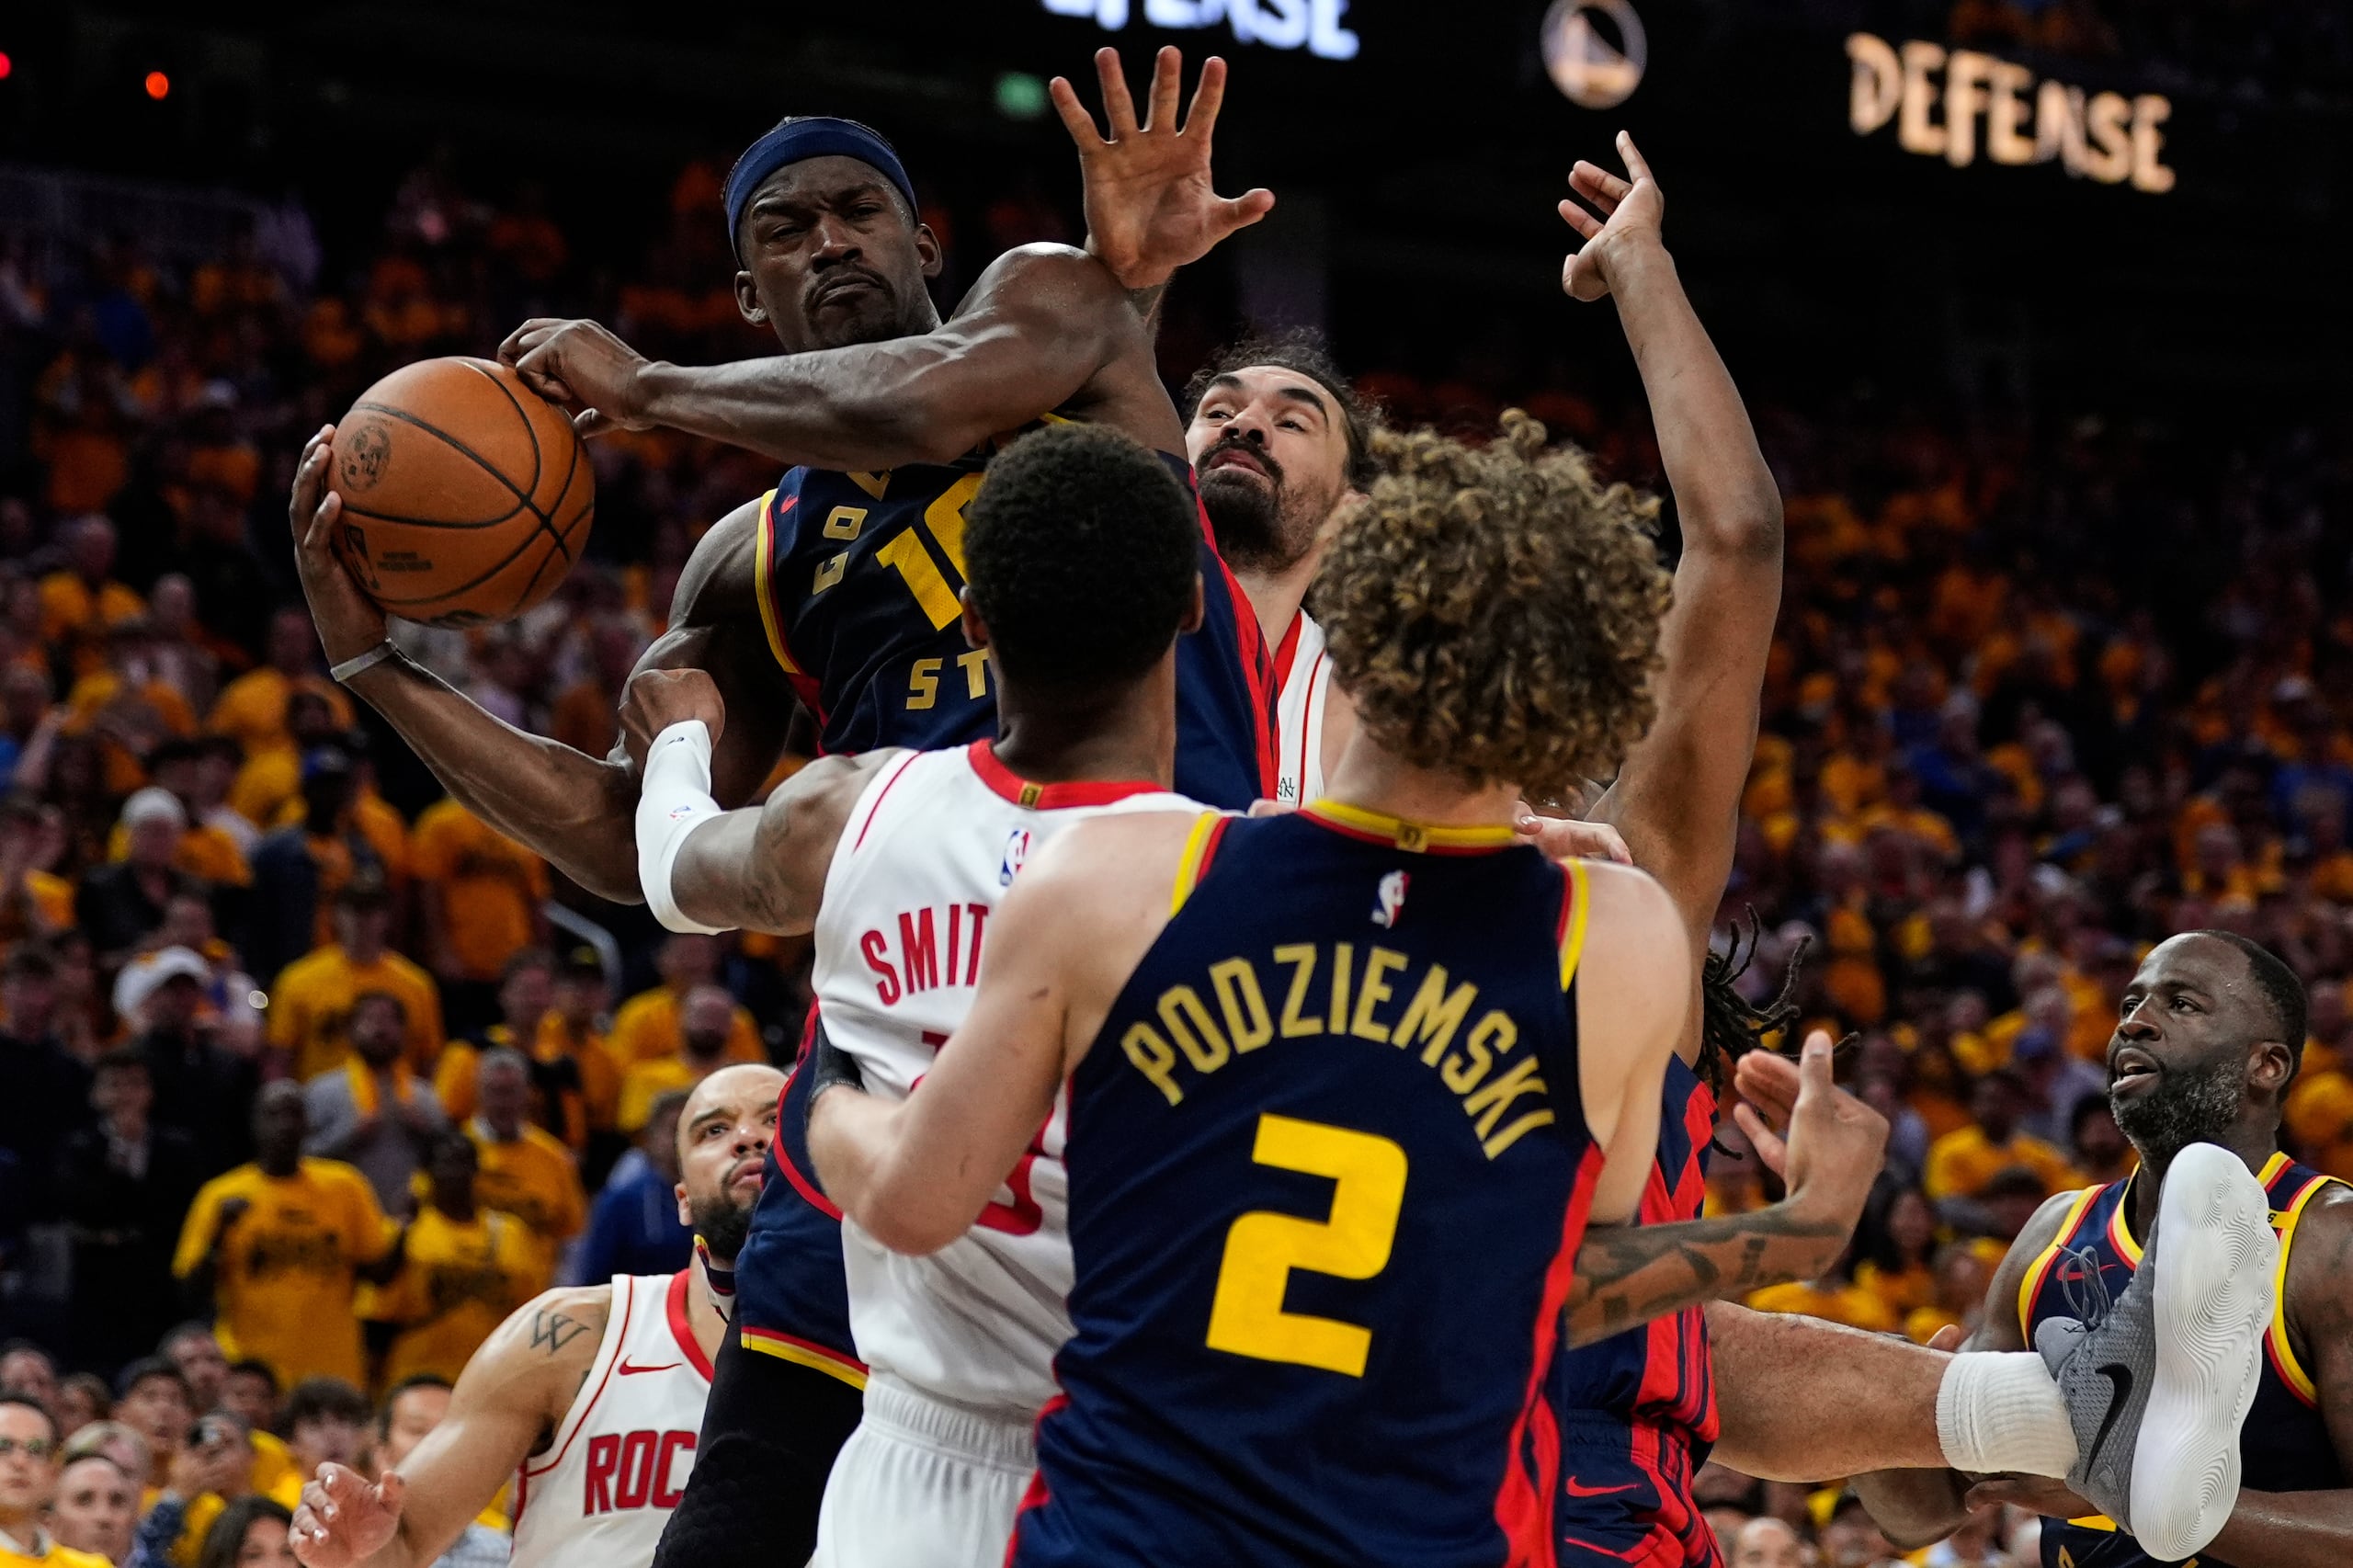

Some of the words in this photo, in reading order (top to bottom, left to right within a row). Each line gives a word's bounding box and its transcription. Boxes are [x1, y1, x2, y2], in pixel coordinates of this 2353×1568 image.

[1845, 32, 2176, 194] DEFENSE
[905, 648, 989, 710] ST
[860, 903, 989, 1006] SMIT
[1121, 942, 1555, 1161] PODZIEMSKI
[1205, 1112, 1409, 1378] 2
[584, 1430, 697, 1517] ROC
